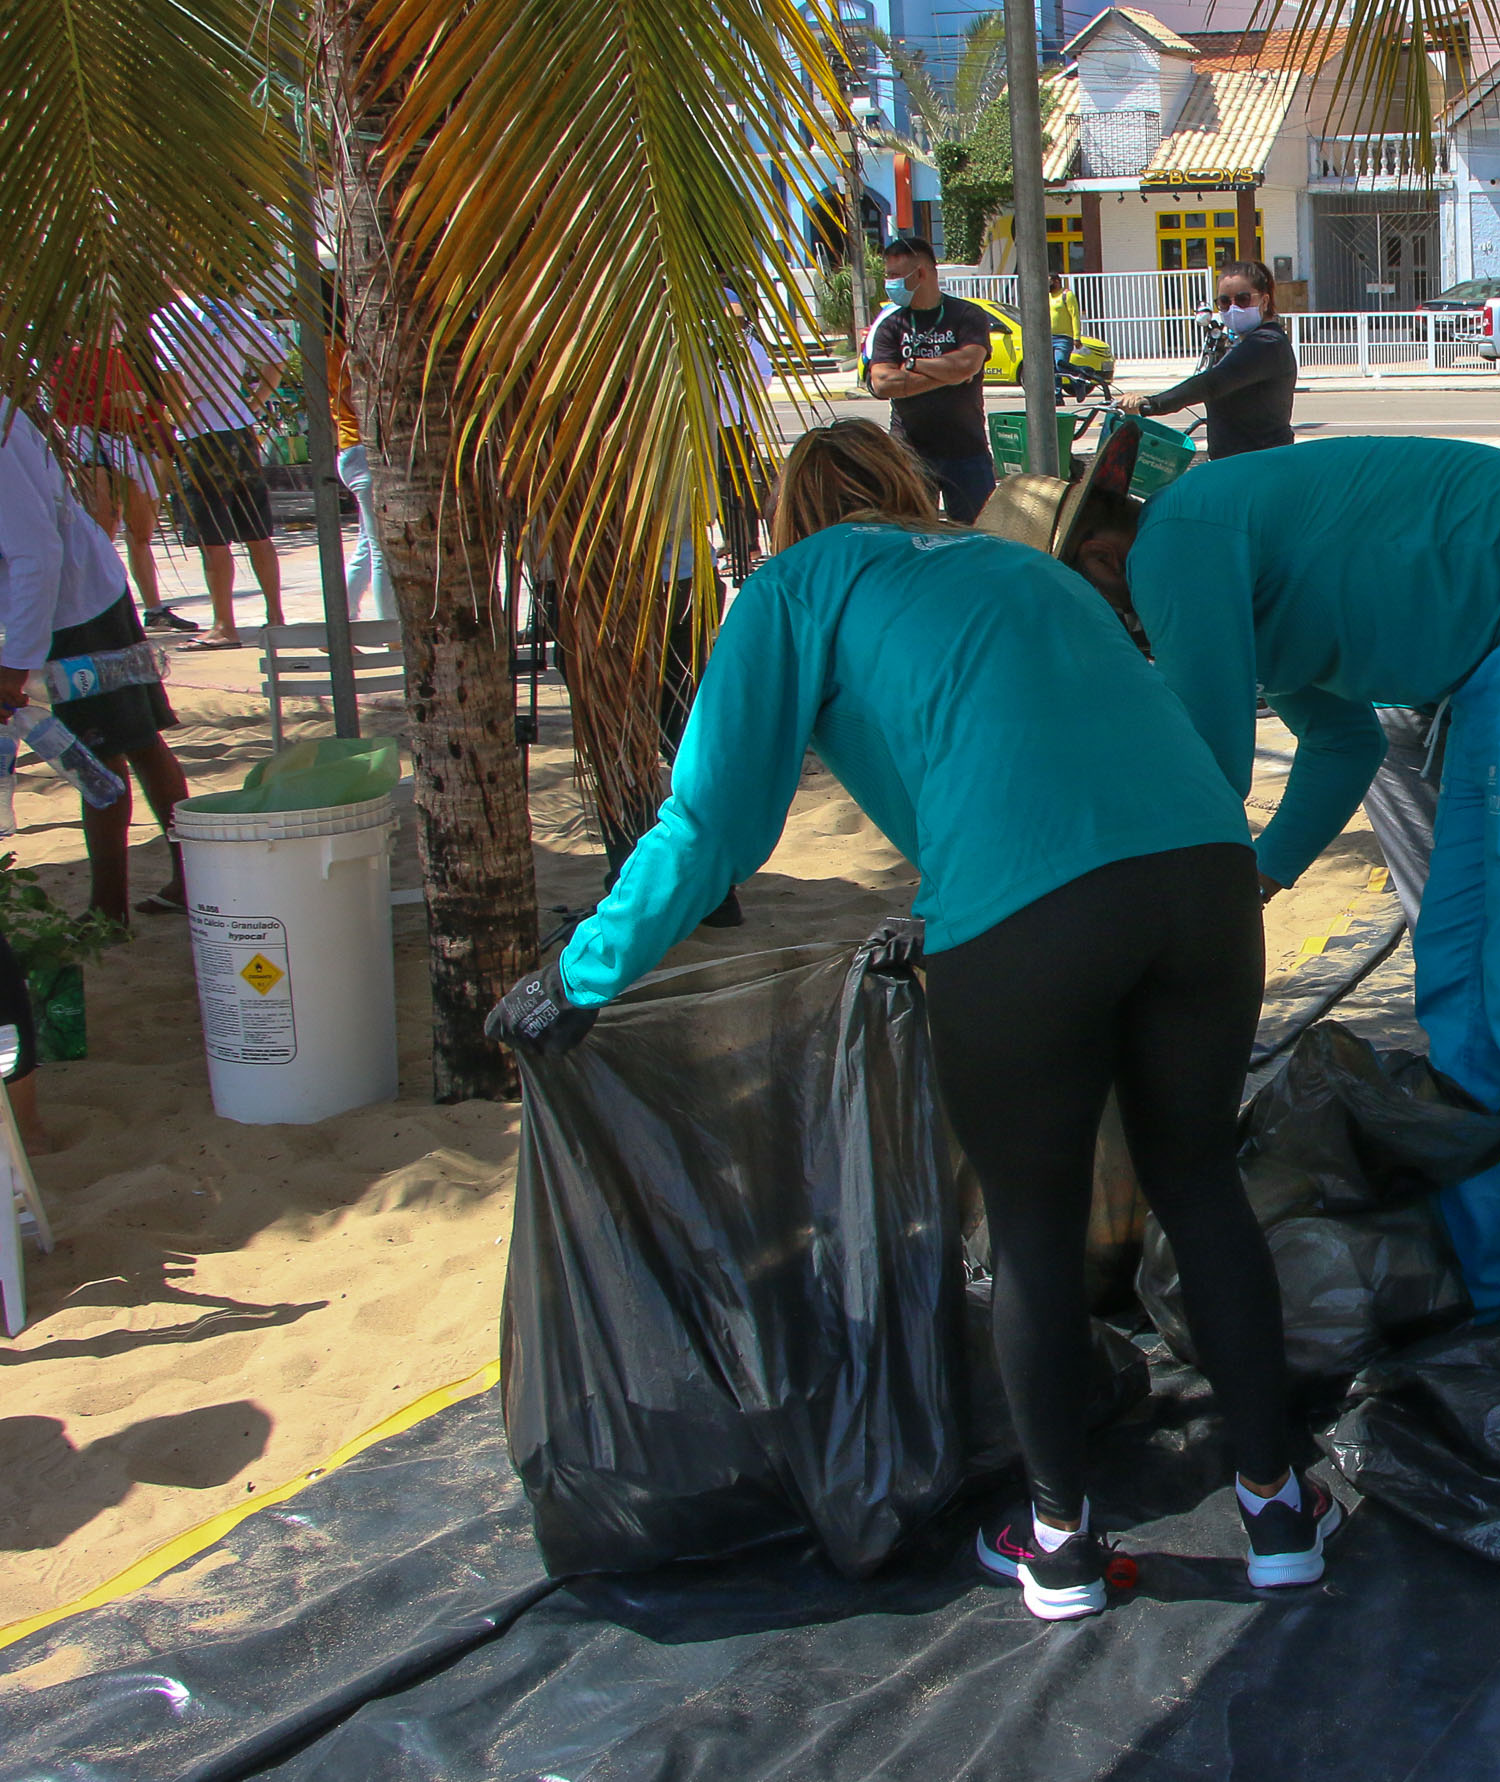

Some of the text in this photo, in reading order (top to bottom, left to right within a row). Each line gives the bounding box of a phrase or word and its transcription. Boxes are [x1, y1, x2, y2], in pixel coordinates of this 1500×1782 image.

[231, 921, 280, 930] Granulado
[228, 931, 267, 941] hypocal
[526, 981, 540, 995] 8
